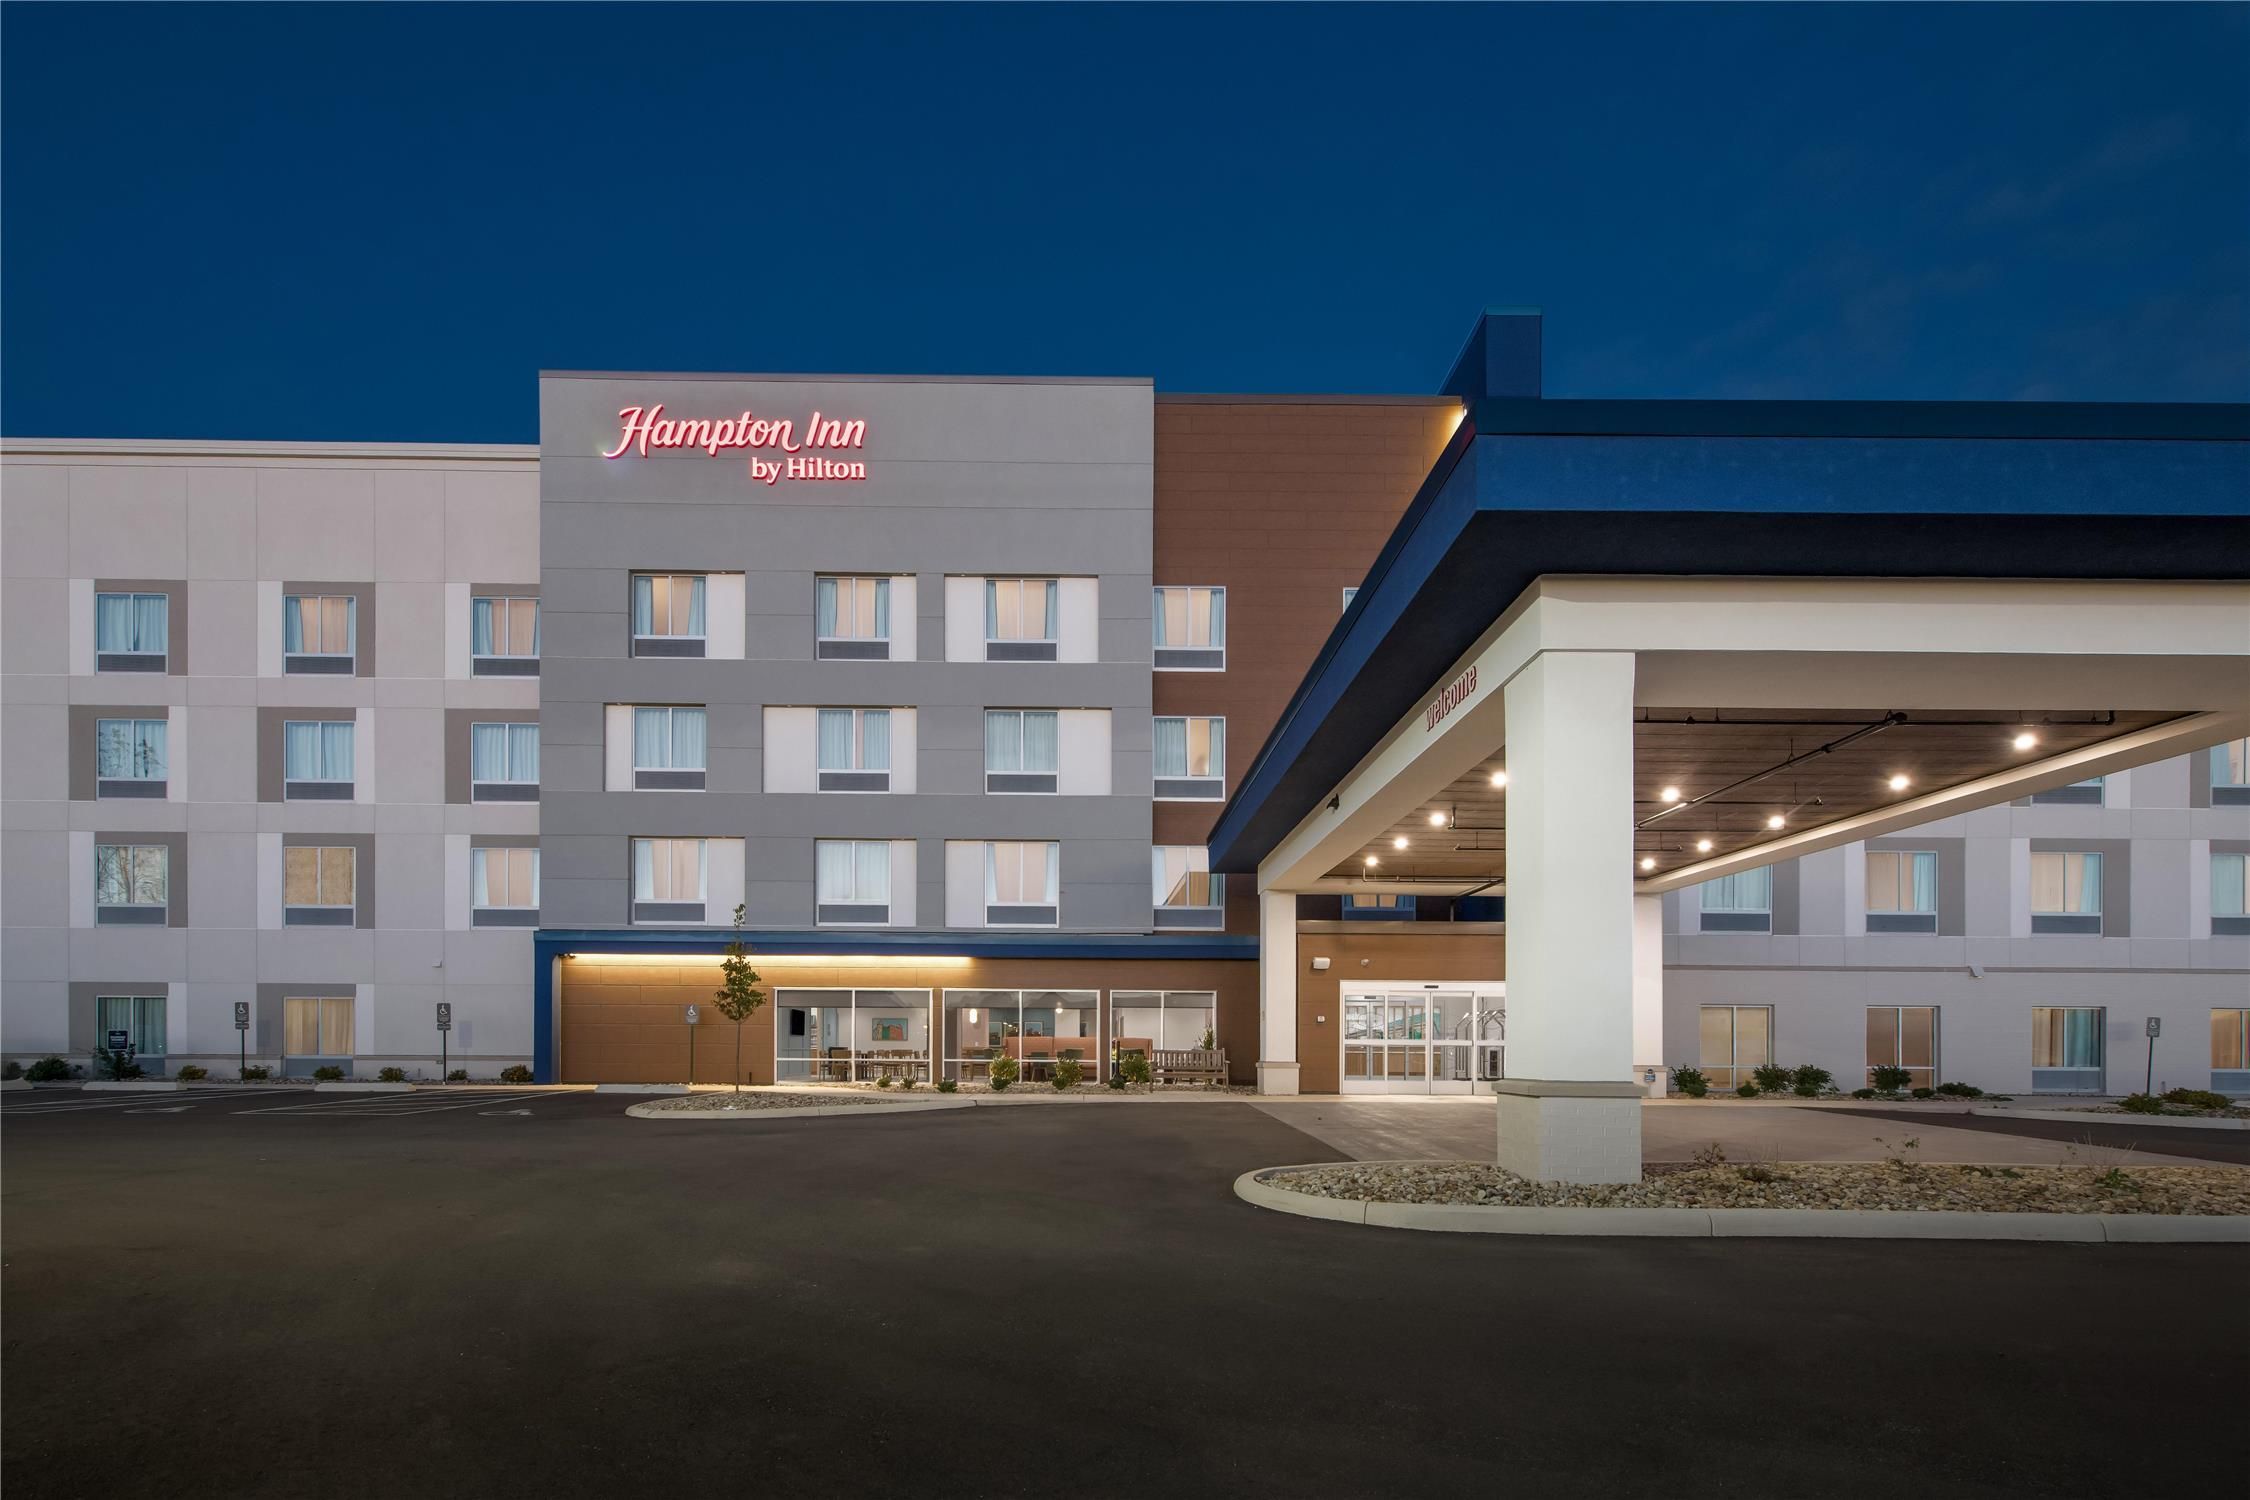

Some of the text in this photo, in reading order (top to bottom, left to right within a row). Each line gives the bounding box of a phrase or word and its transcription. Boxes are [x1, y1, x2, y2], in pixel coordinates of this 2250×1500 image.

[602, 404, 866, 458] Hampton Inn
[752, 457, 866, 485] by Hilton
[1426, 665, 1477, 732] welcome
